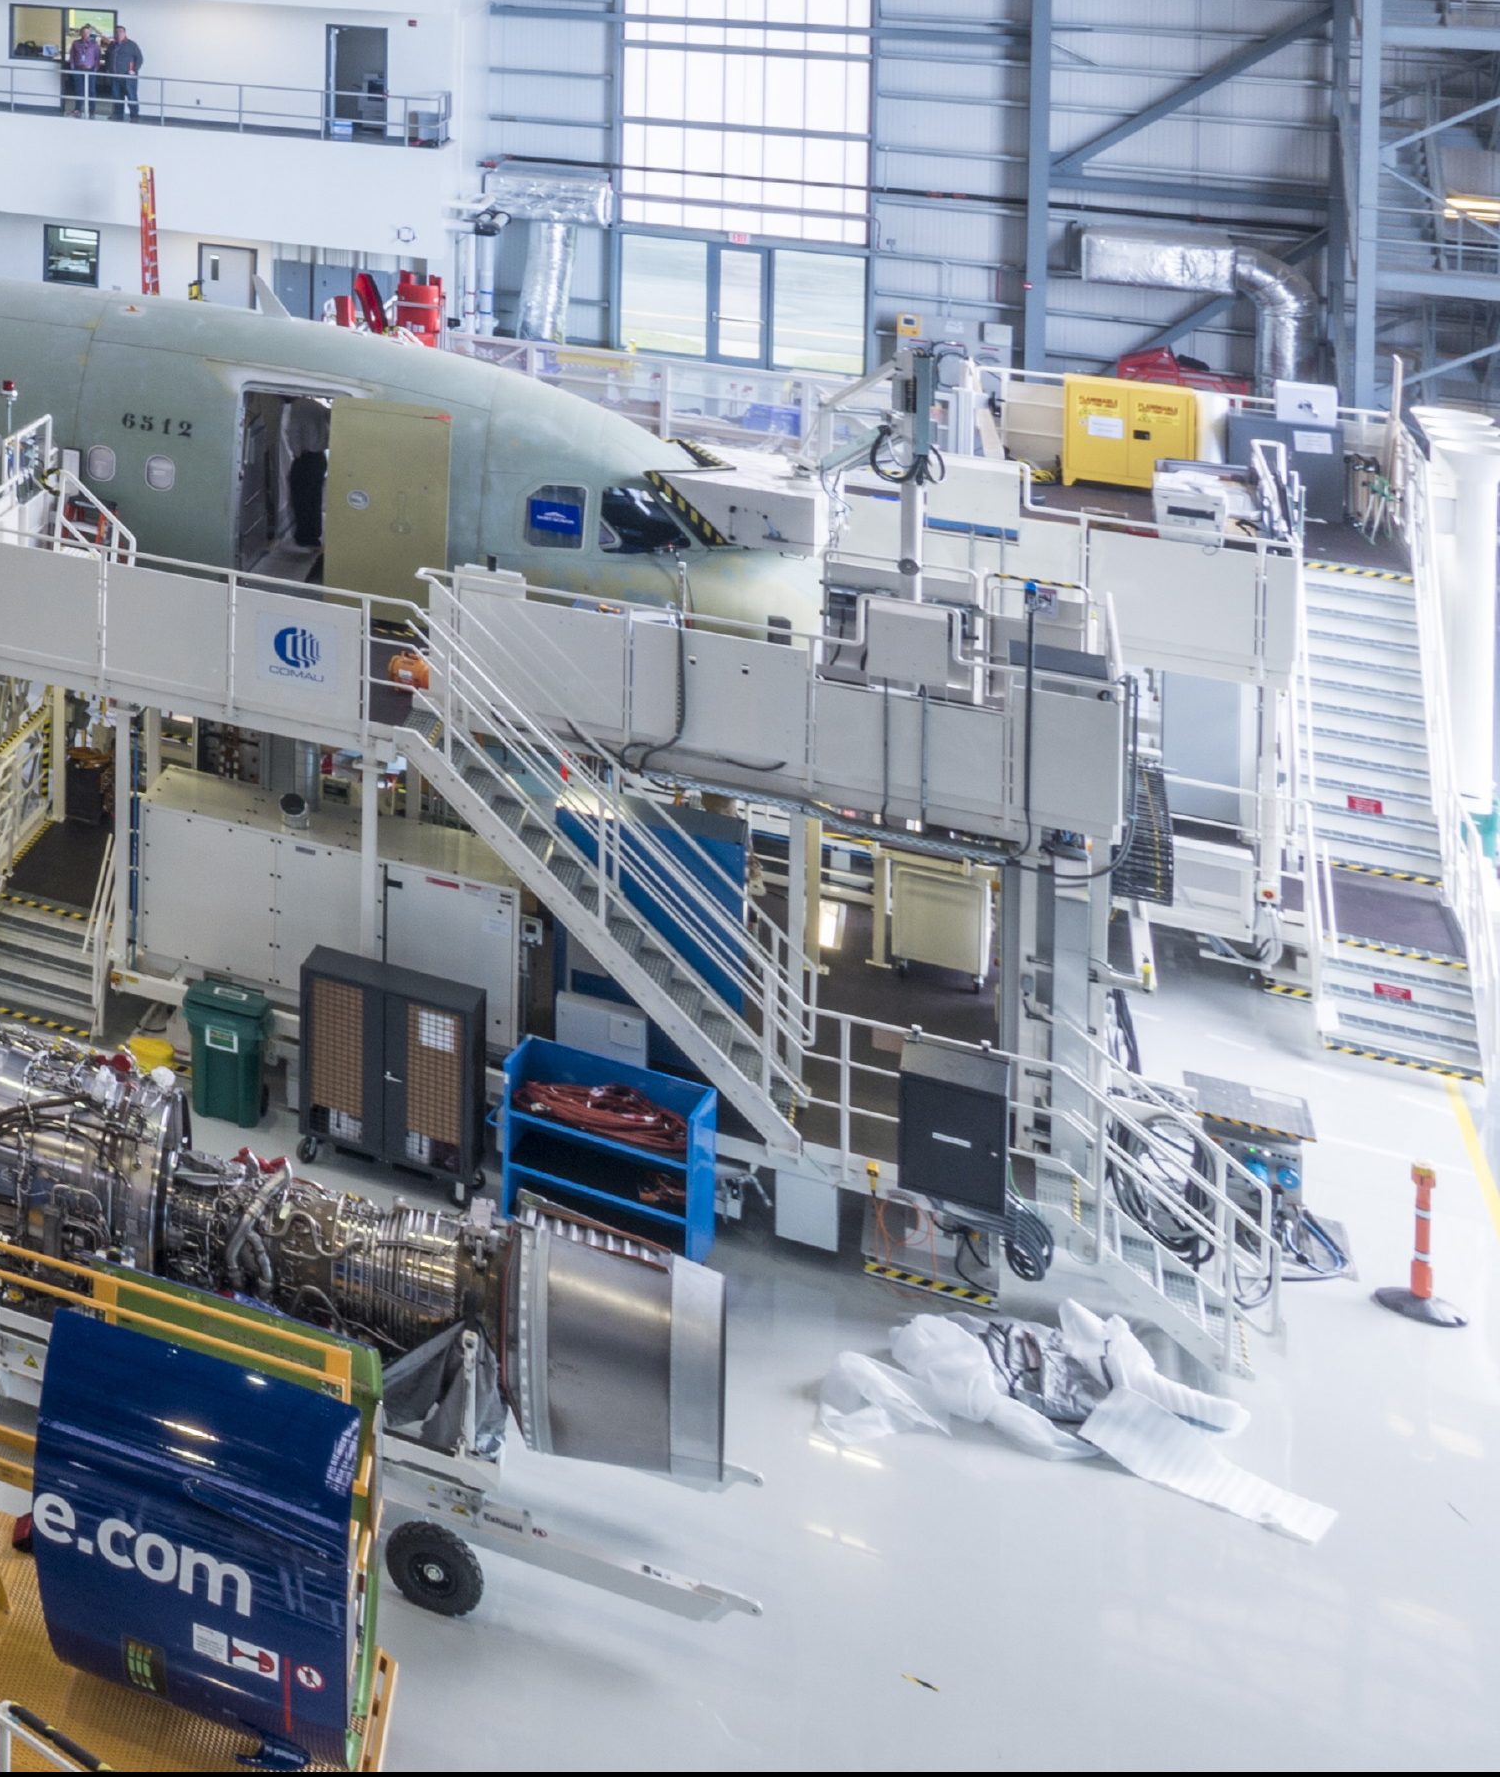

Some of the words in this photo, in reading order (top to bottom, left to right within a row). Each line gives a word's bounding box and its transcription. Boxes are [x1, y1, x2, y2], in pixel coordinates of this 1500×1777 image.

[122, 413, 193, 437] 6512
[269, 665, 325, 683] COMAU
[31, 1488, 253, 1618] e.com
